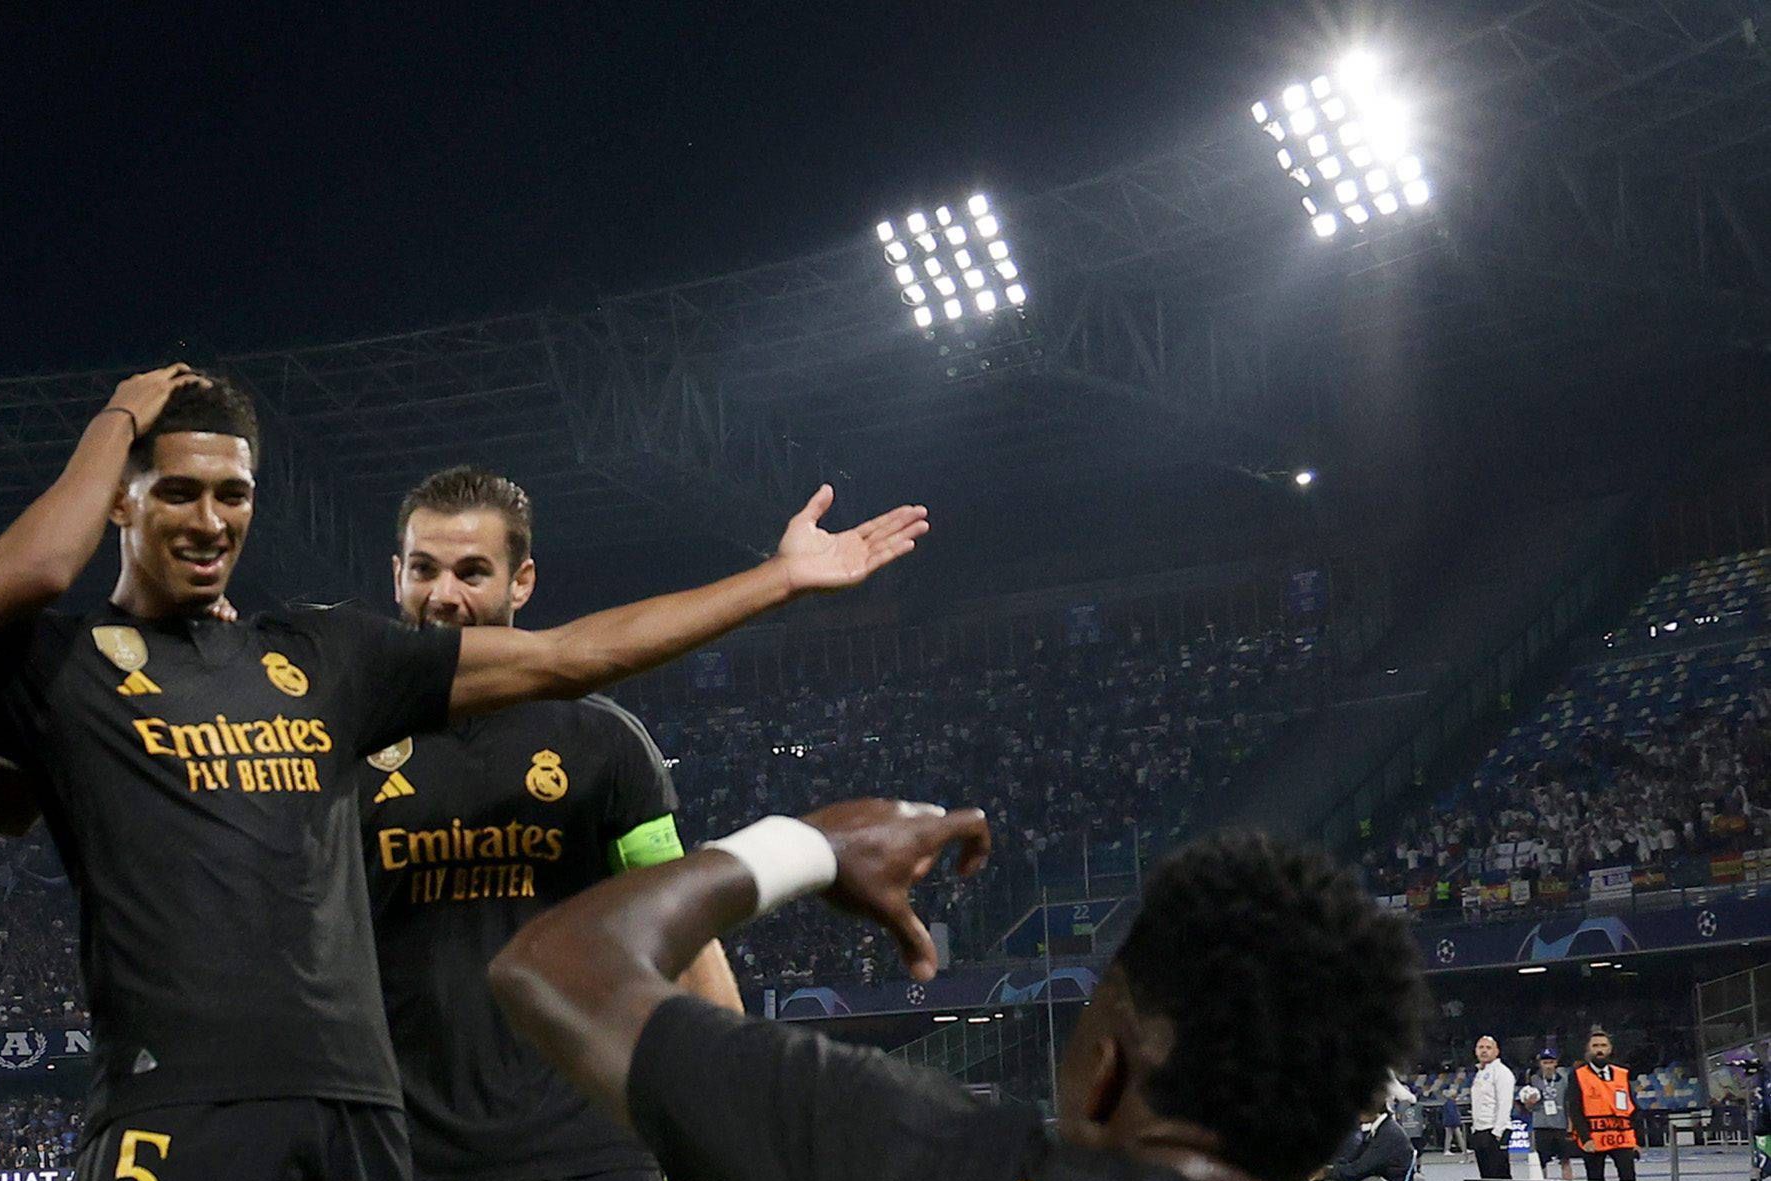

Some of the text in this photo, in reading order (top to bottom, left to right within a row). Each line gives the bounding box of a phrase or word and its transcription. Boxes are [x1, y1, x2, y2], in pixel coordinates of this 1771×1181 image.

[132, 713, 333, 759] Emirates
[185, 757, 322, 793] FLY BETTER
[378, 817, 565, 871] Emirates
[451, 864, 536, 899] BETTER
